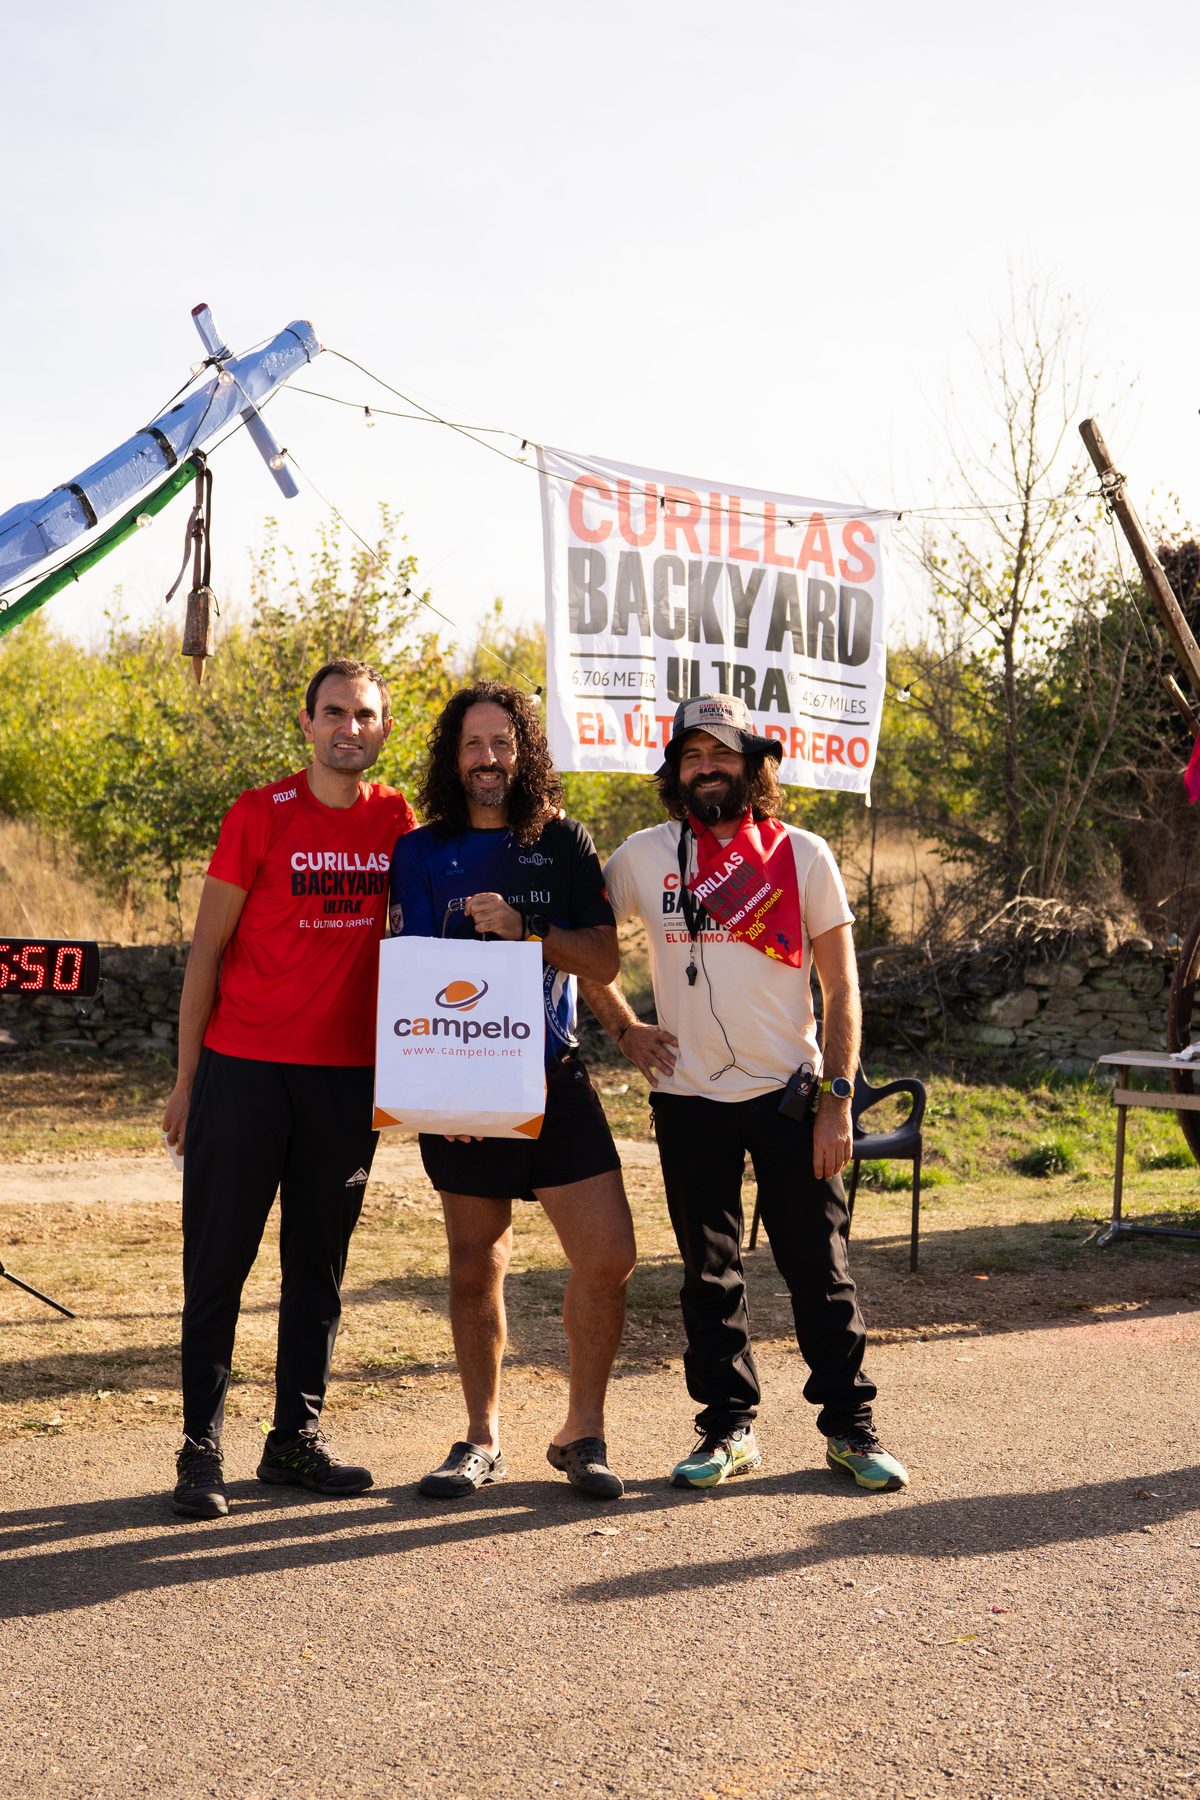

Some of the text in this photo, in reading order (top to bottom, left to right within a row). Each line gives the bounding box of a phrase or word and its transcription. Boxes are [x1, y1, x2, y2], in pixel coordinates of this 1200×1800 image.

[568, 474, 876, 583] CURILLAS
[567, 546, 875, 667] BACKYARD
[830, 696, 867, 714] MILES
[576, 711, 617, 746] EL
[290, 852, 390, 872] CURILLAS
[323, 899, 363, 914] ULTRA
[744, 882, 771, 912] ARRIERO
[754, 888, 784, 919] SOLIDARIA
[299, 919, 311, 928] EL
[313, 918, 344, 929] ÚLTIMO
[745, 919, 766, 940] 2026
[665, 932, 678, 944] EL
[393, 1015, 531, 1045] campelo
[402, 1045, 523, 1060] www.campelo.net
